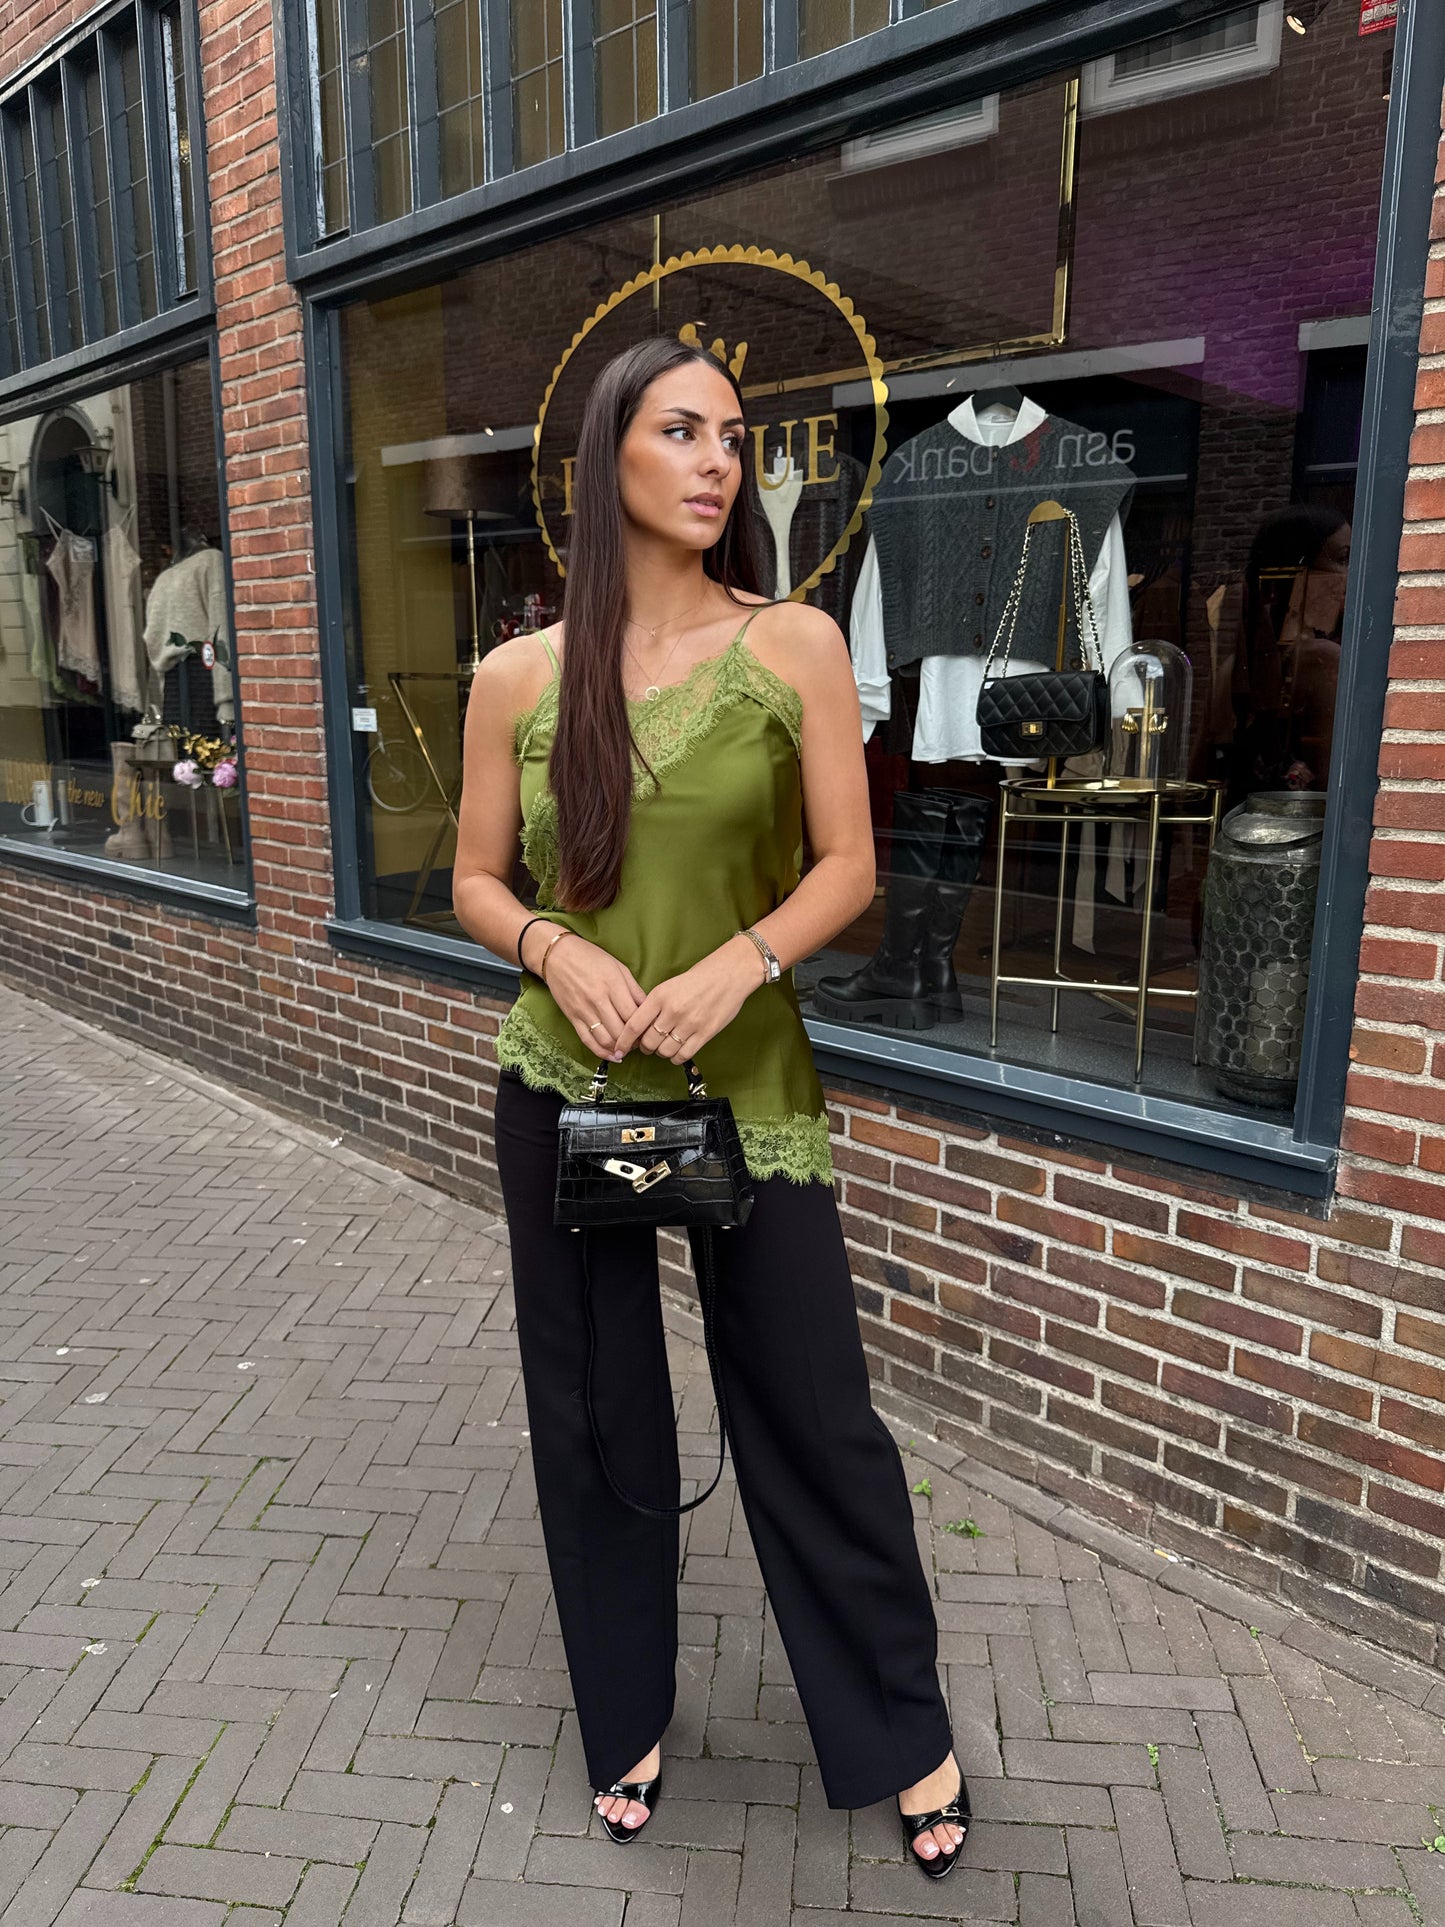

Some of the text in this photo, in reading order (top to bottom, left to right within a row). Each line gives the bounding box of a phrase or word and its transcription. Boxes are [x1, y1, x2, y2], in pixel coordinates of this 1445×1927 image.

[68, 778, 82, 803] the
[84, 790, 105, 808] new
[112, 772, 167, 826] Chic
